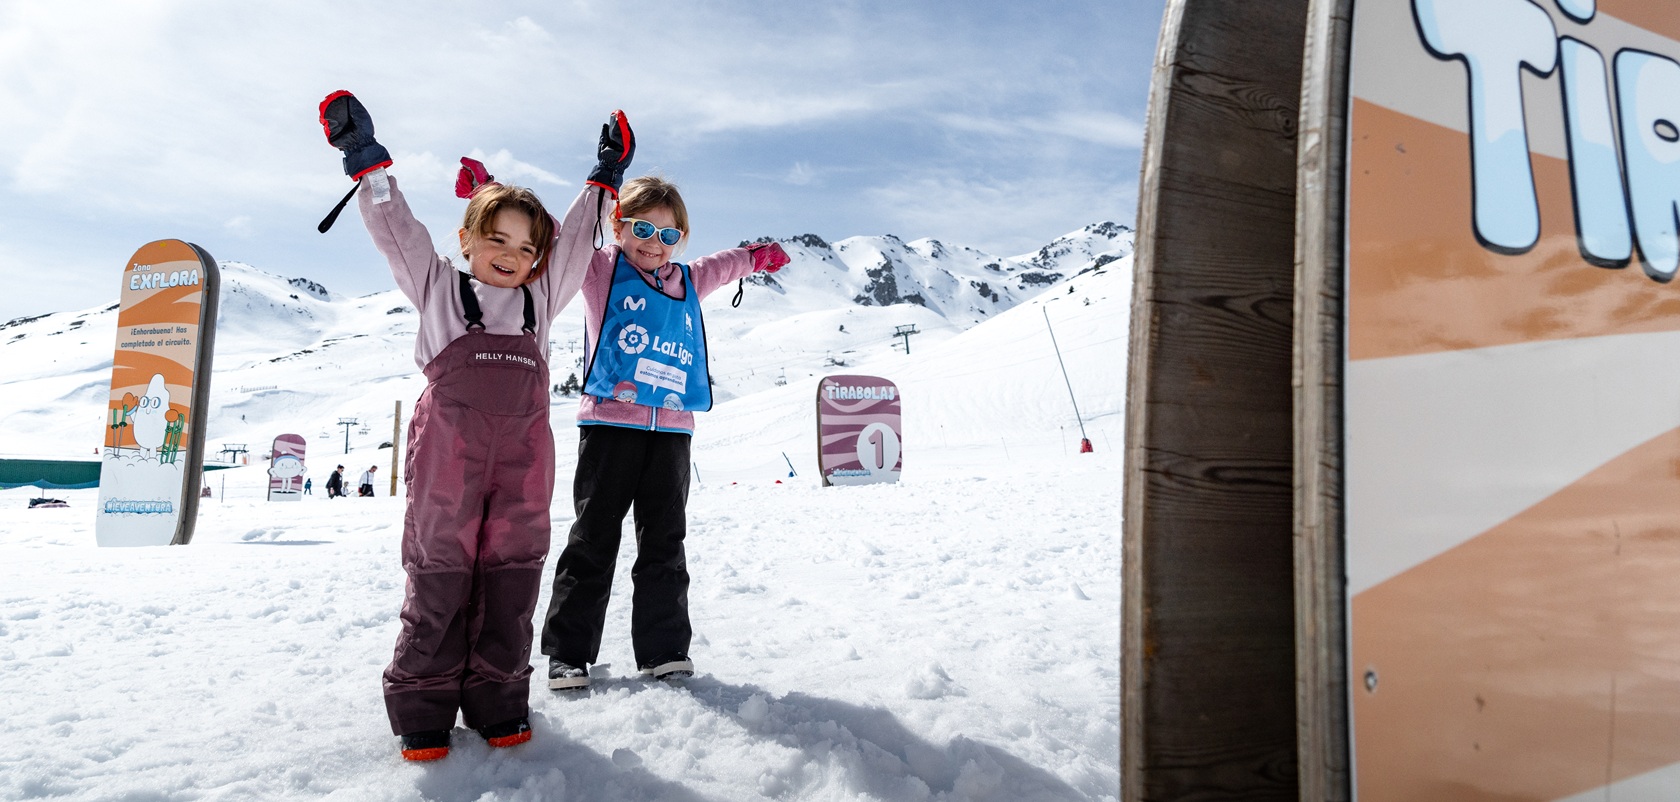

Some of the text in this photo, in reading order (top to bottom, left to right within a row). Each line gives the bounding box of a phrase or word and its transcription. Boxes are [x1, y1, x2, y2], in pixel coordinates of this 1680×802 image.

[132, 263, 151, 272] Zona
[129, 269, 199, 291] EXPLORA
[130, 326, 187, 336] ¡Enhorabuena! Has
[120, 339, 156, 349] completado
[157, 339, 163, 347] el
[652, 335, 693, 366] LaLiga
[475, 352, 536, 367] HELLY HANSEN
[868, 429, 884, 469] 1
